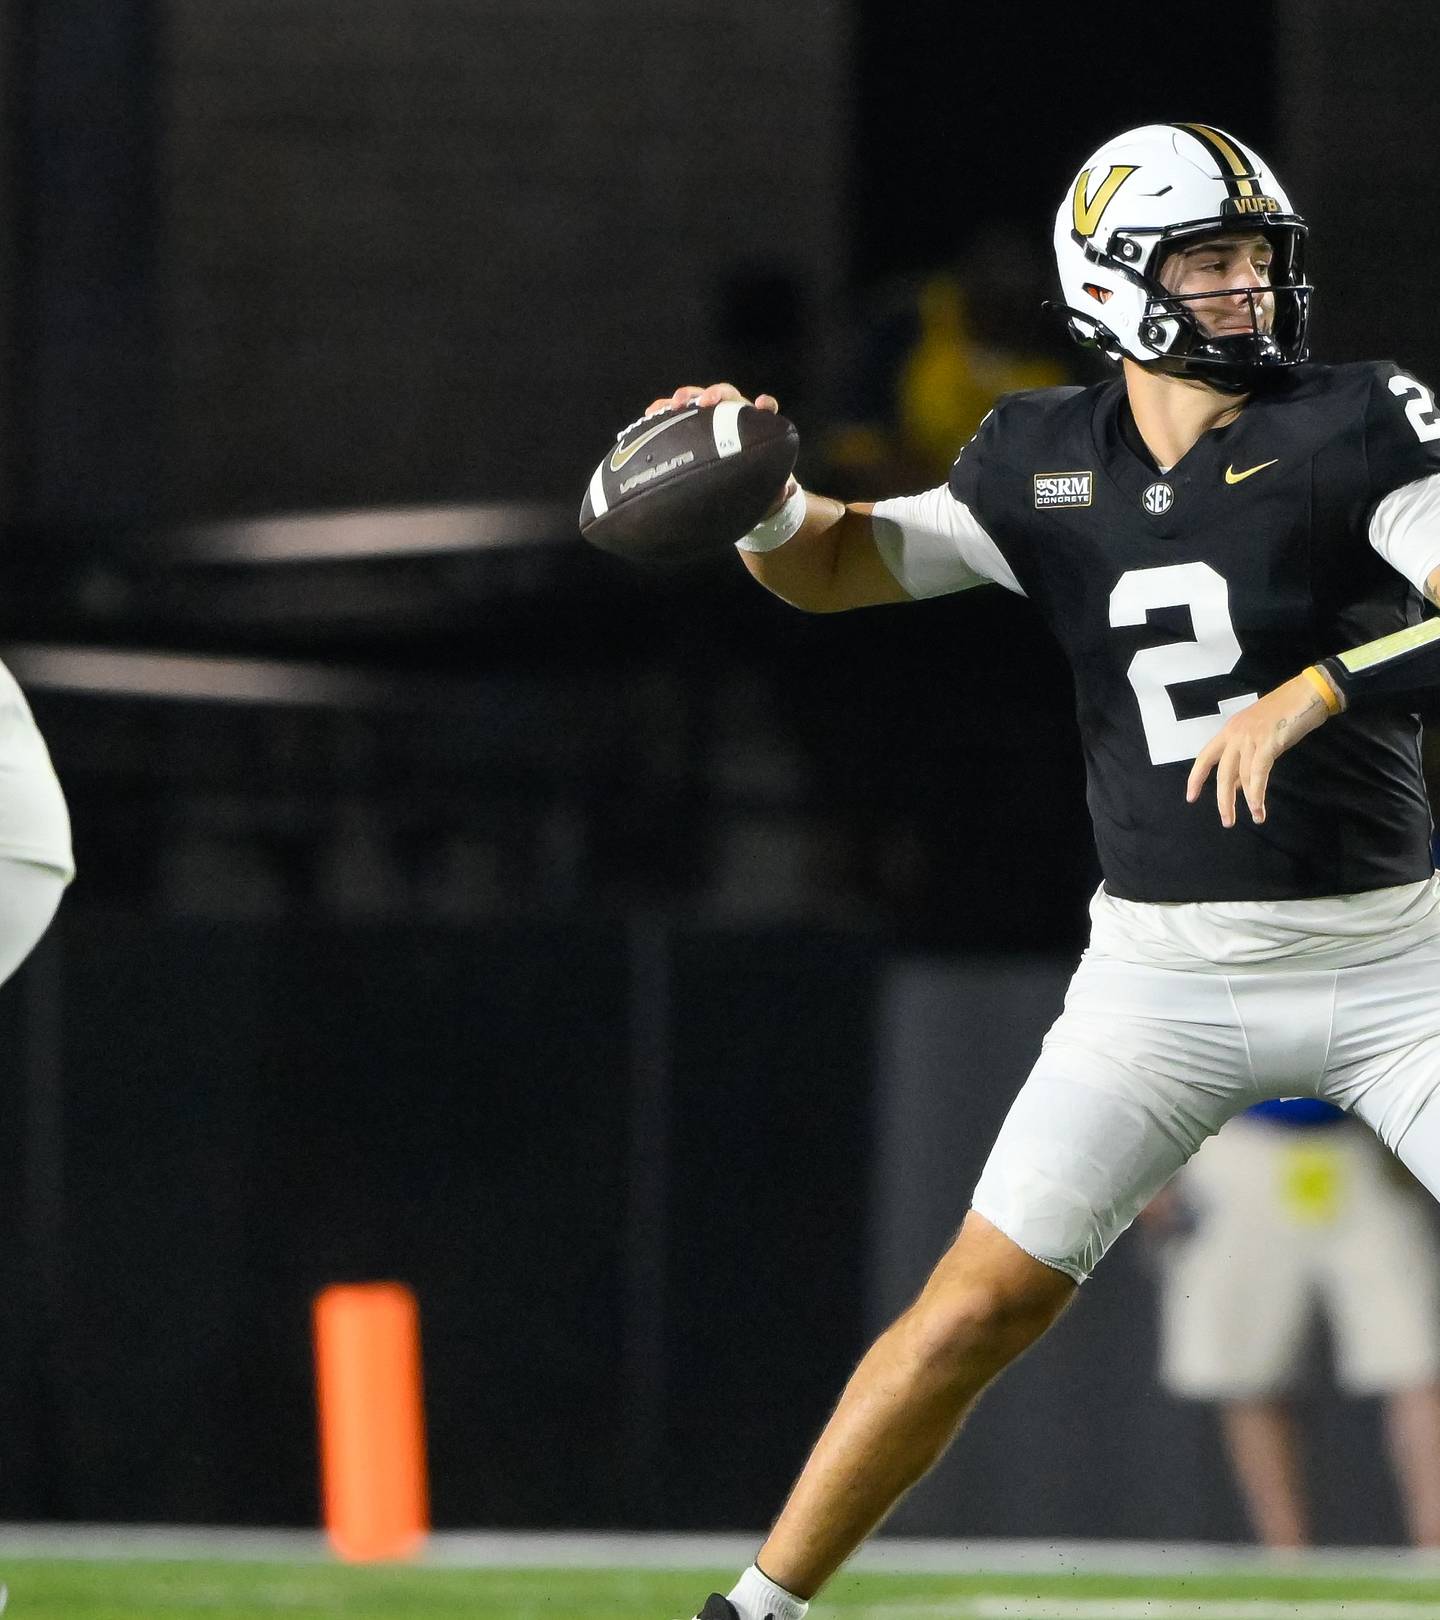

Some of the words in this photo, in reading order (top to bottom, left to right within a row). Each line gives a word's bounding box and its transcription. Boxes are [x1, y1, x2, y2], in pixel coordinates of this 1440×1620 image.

[1072, 164, 1143, 237] V
[1233, 197, 1278, 214] VUFB
[1046, 476, 1089, 496] SRM
[1145, 484, 1172, 512] SEC
[1037, 495, 1089, 504] CONCRETE
[1109, 561, 1262, 766] 2
